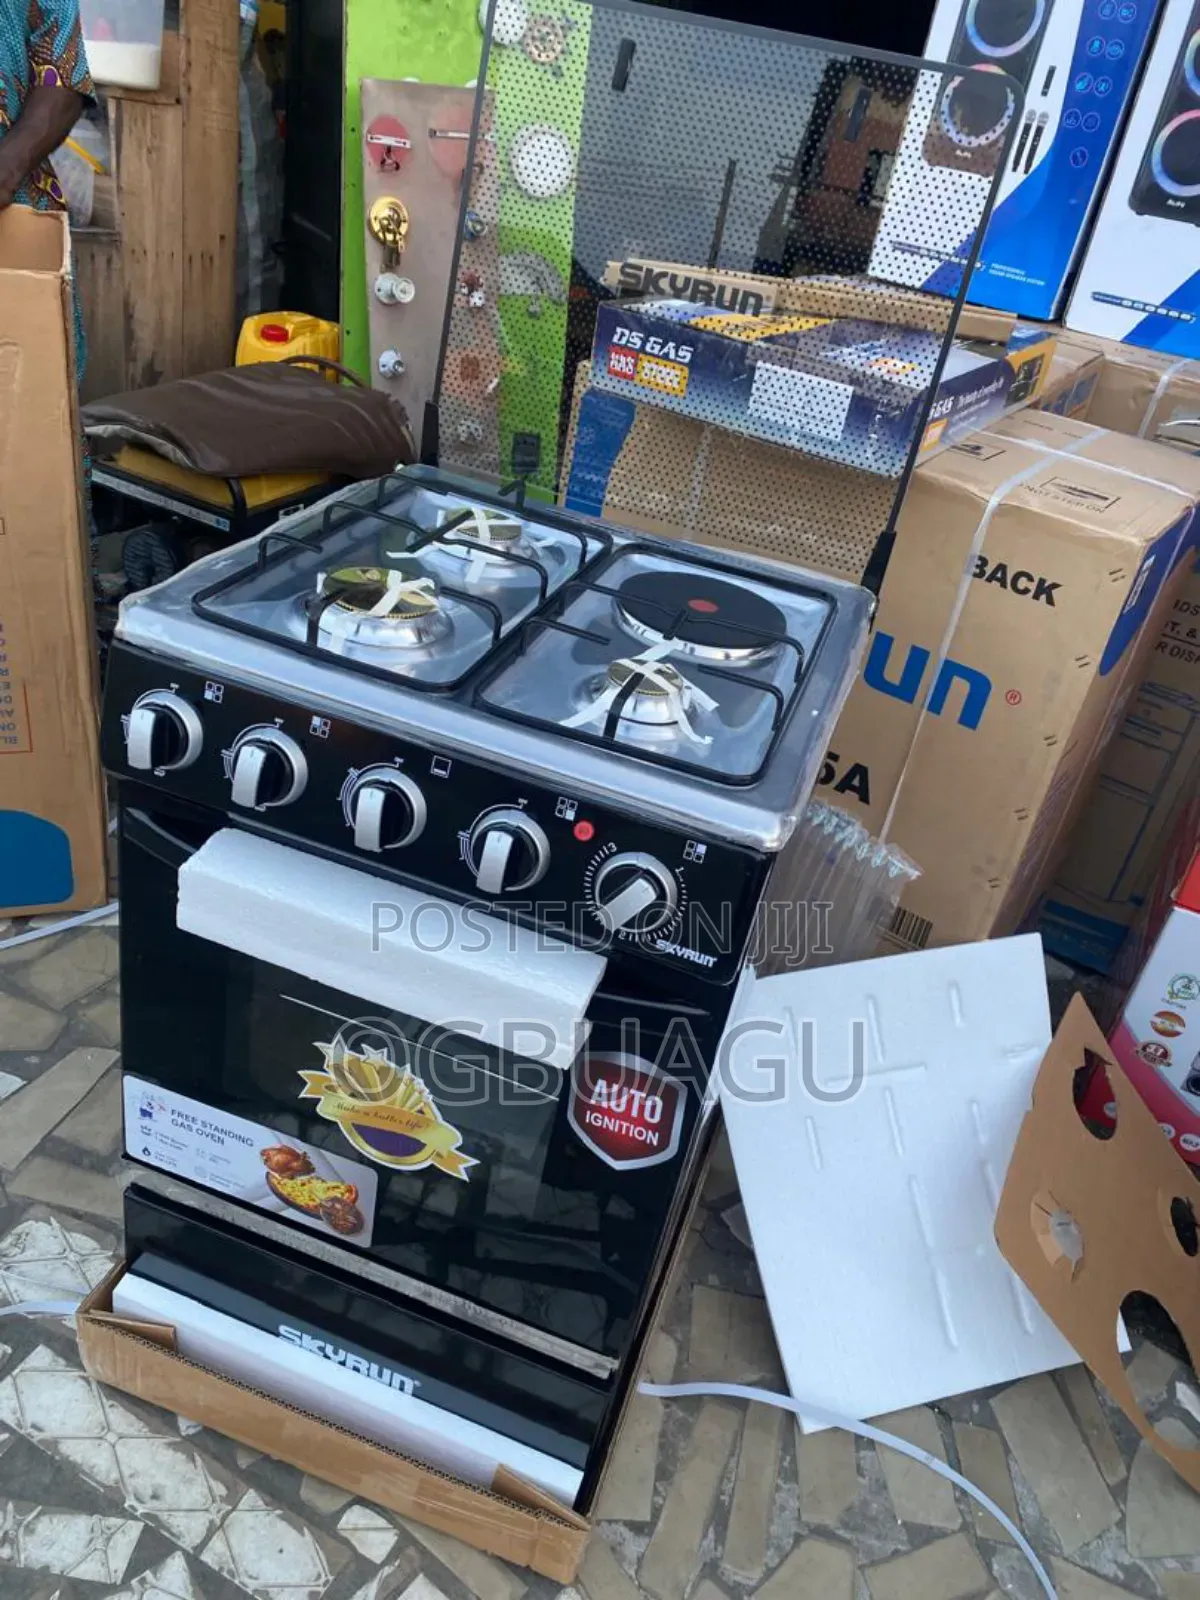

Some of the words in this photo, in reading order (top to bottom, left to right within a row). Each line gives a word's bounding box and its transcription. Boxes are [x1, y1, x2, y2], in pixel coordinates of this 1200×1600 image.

[612, 326, 644, 349] DS
[645, 336, 694, 364] GAS
[972, 555, 1063, 607] BACK
[590, 1078, 663, 1124] AUTO
[170, 1108, 198, 1126] FREE
[200, 1119, 255, 1148] STANDING
[171, 1118, 193, 1133] GAS
[195, 1127, 225, 1146] OVEN
[585, 1110, 659, 1147] IGNITION
